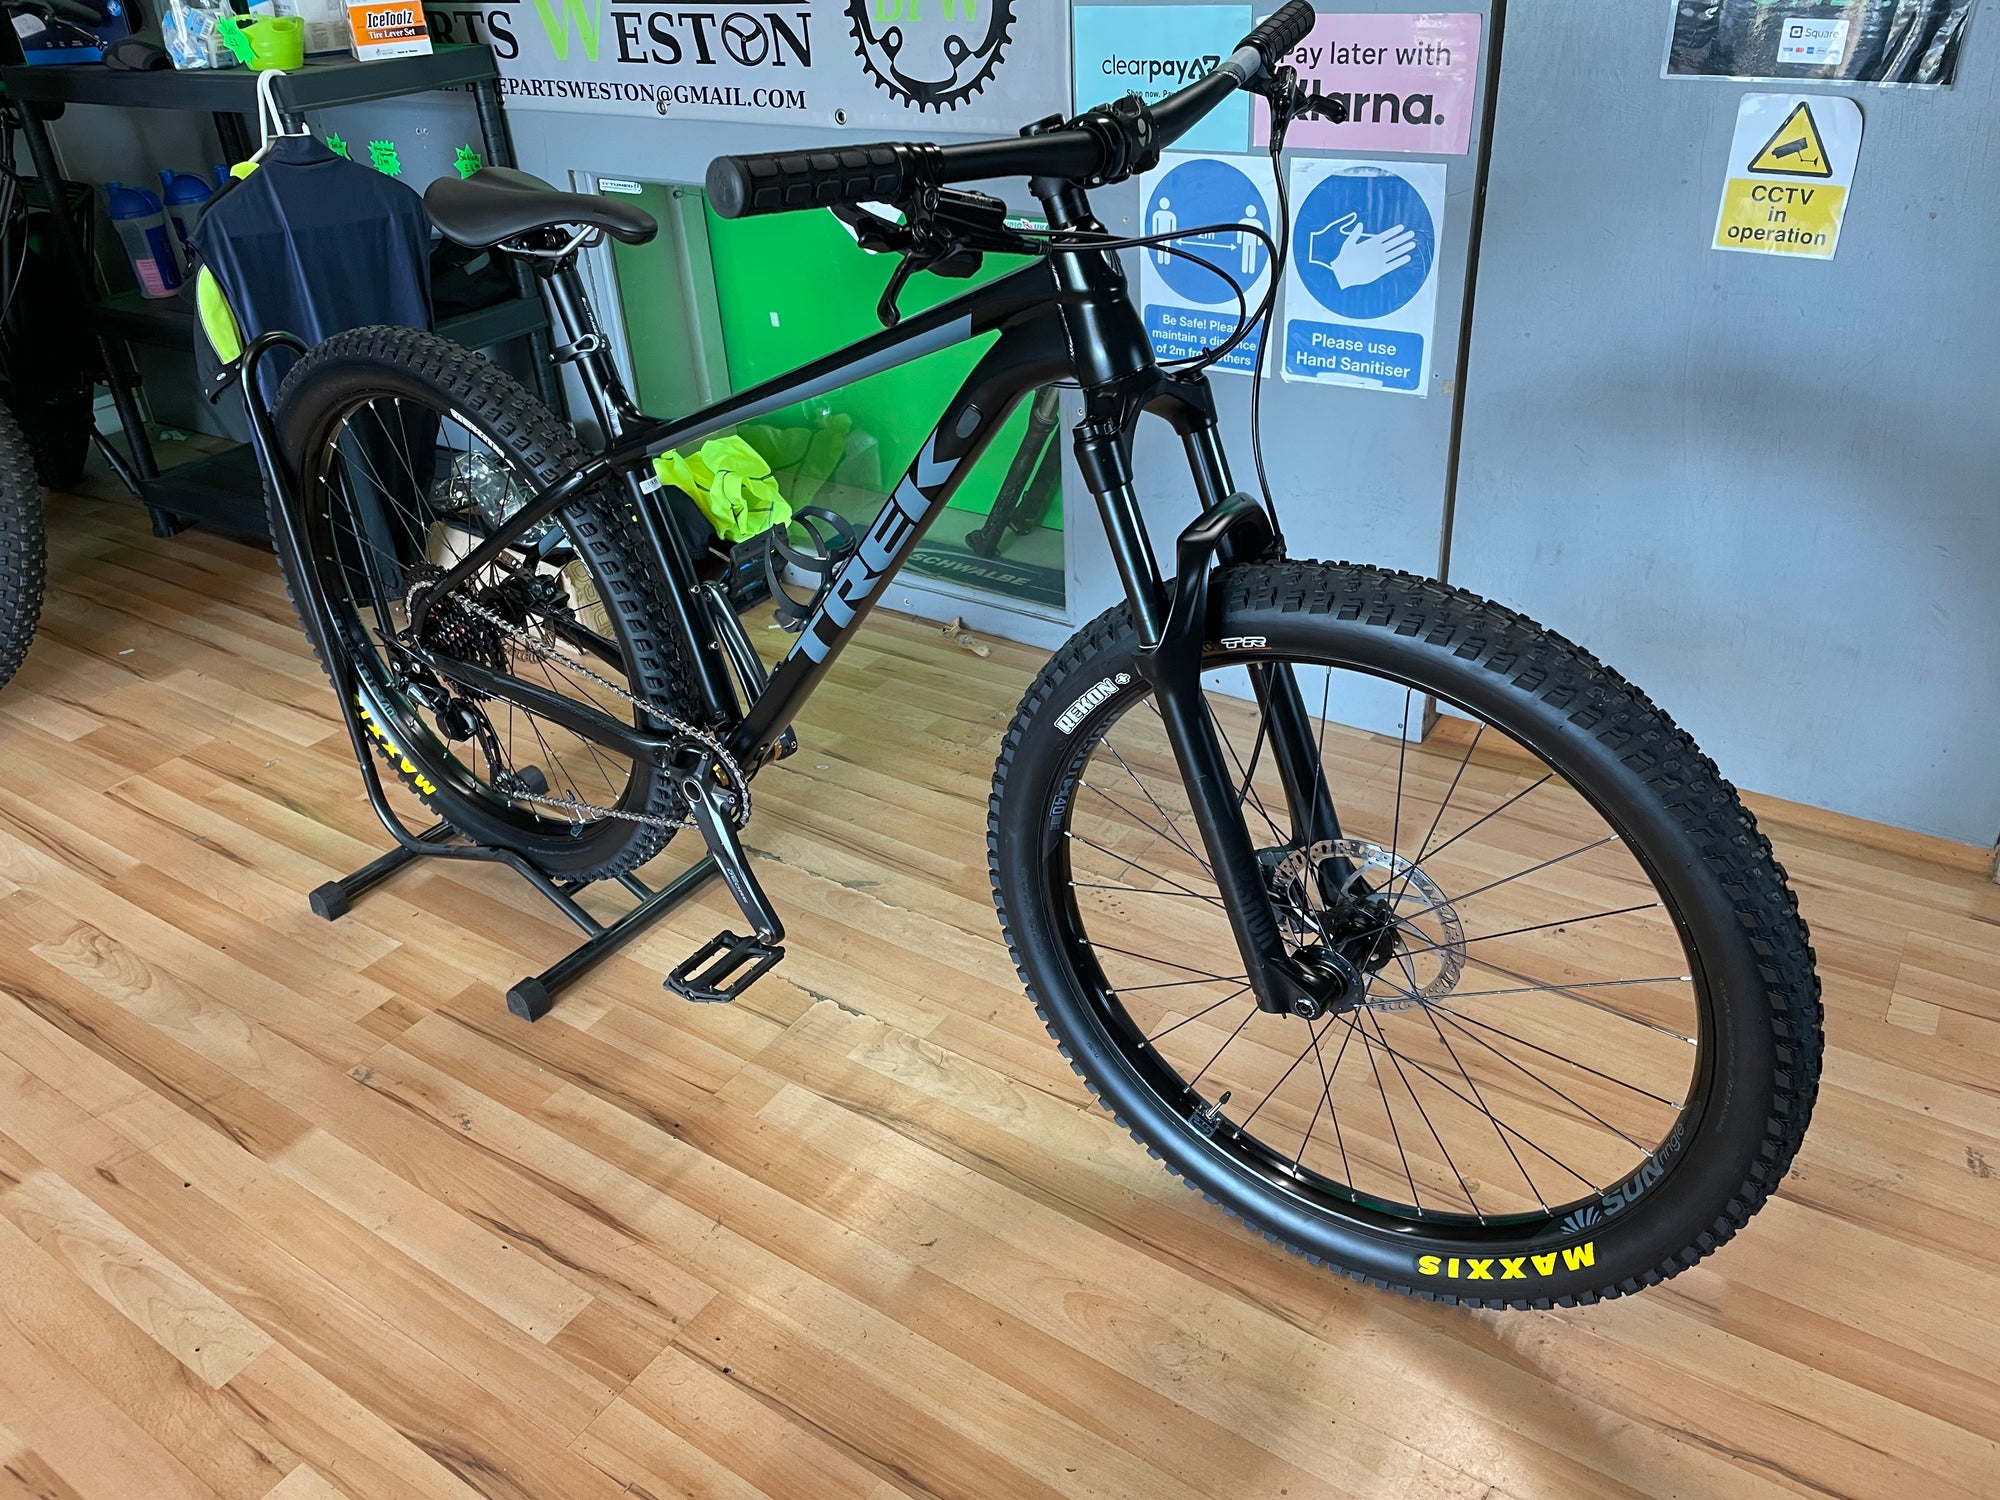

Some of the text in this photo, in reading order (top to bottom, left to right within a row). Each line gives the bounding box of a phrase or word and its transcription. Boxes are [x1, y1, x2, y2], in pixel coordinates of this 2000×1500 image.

[367, 10, 413, 28] IceToolz
[369, 28, 416, 39] Tire Lever Set
[428, 0, 812, 67] RTS WESTON
[1804, 28, 1840, 40] Square
[1330, 41, 1388, 66] later
[1395, 41, 1452, 66] with
[1101, 54, 1189, 84] clearpay
[500, 77, 807, 110] EPARTSWESTON@GMAIL.COM
[1751, 185, 1815, 205] CCTV
[1767, 206, 1787, 223] in
[1727, 225, 1826, 246] operation
[1162, 314, 1237, 333] Be Safe! Plea
[1152, 329, 1256, 351] maintain a disnce
[1311, 332, 1397, 356] Please use
[1156, 343, 1251, 366] of 2m fro thers
[1296, 351, 1411, 379] Hand Sanitiser
[787, 427, 962, 665] TREK
[910, 553, 1032, 586] SCHWALBE
[1220, 636, 1267, 649] TR
[1053, 677, 1120, 735] REKON
[1417, 1241, 1596, 1281] MAXXIS
